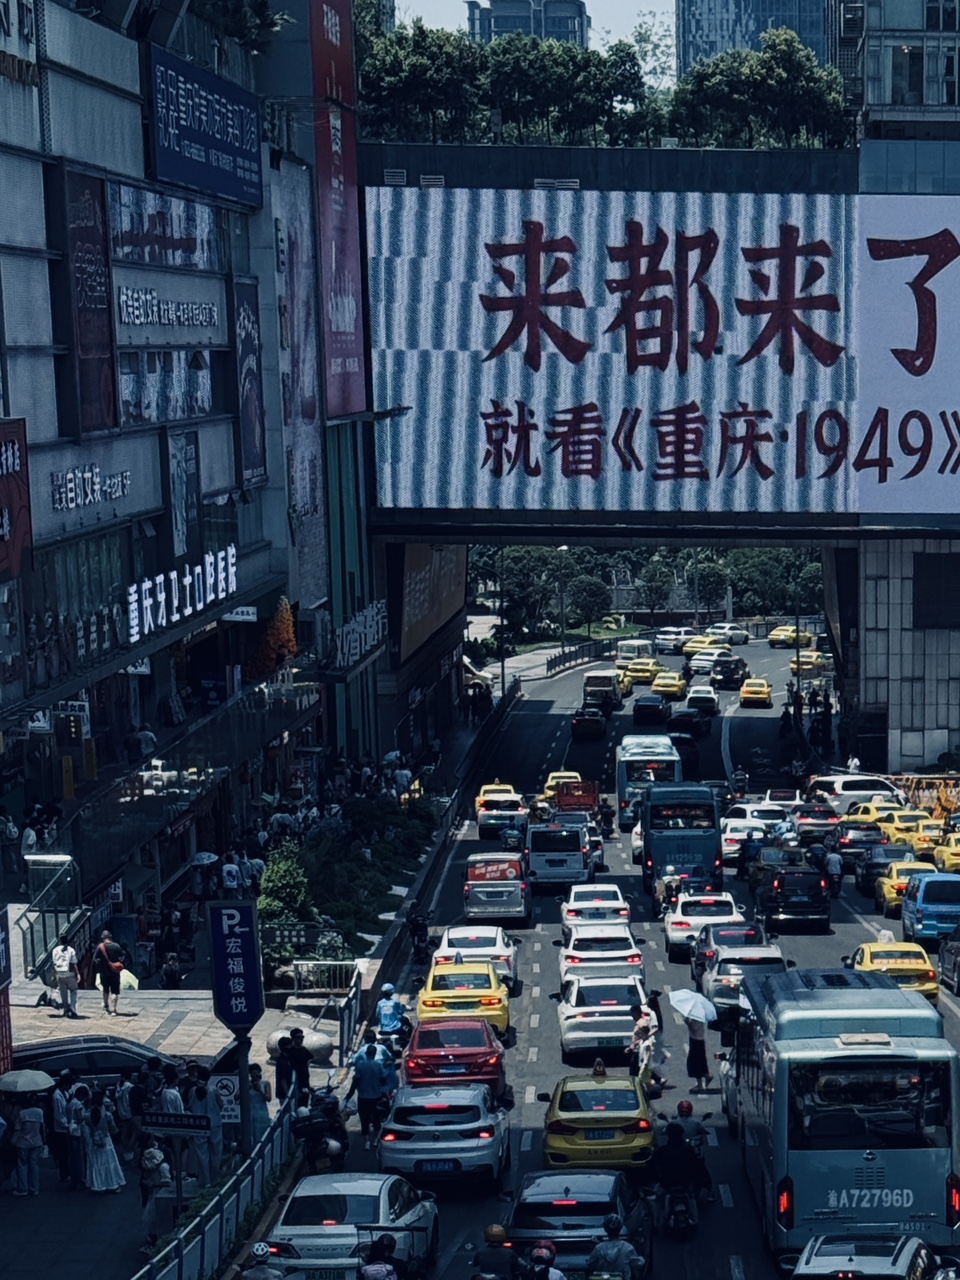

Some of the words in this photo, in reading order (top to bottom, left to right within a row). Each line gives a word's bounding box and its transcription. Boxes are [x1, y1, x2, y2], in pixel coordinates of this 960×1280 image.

[221, 909, 241, 935] P
[225, 937, 248, 1014] 宏福俊悦
[827, 1188, 915, 1209] 渝A72796D
